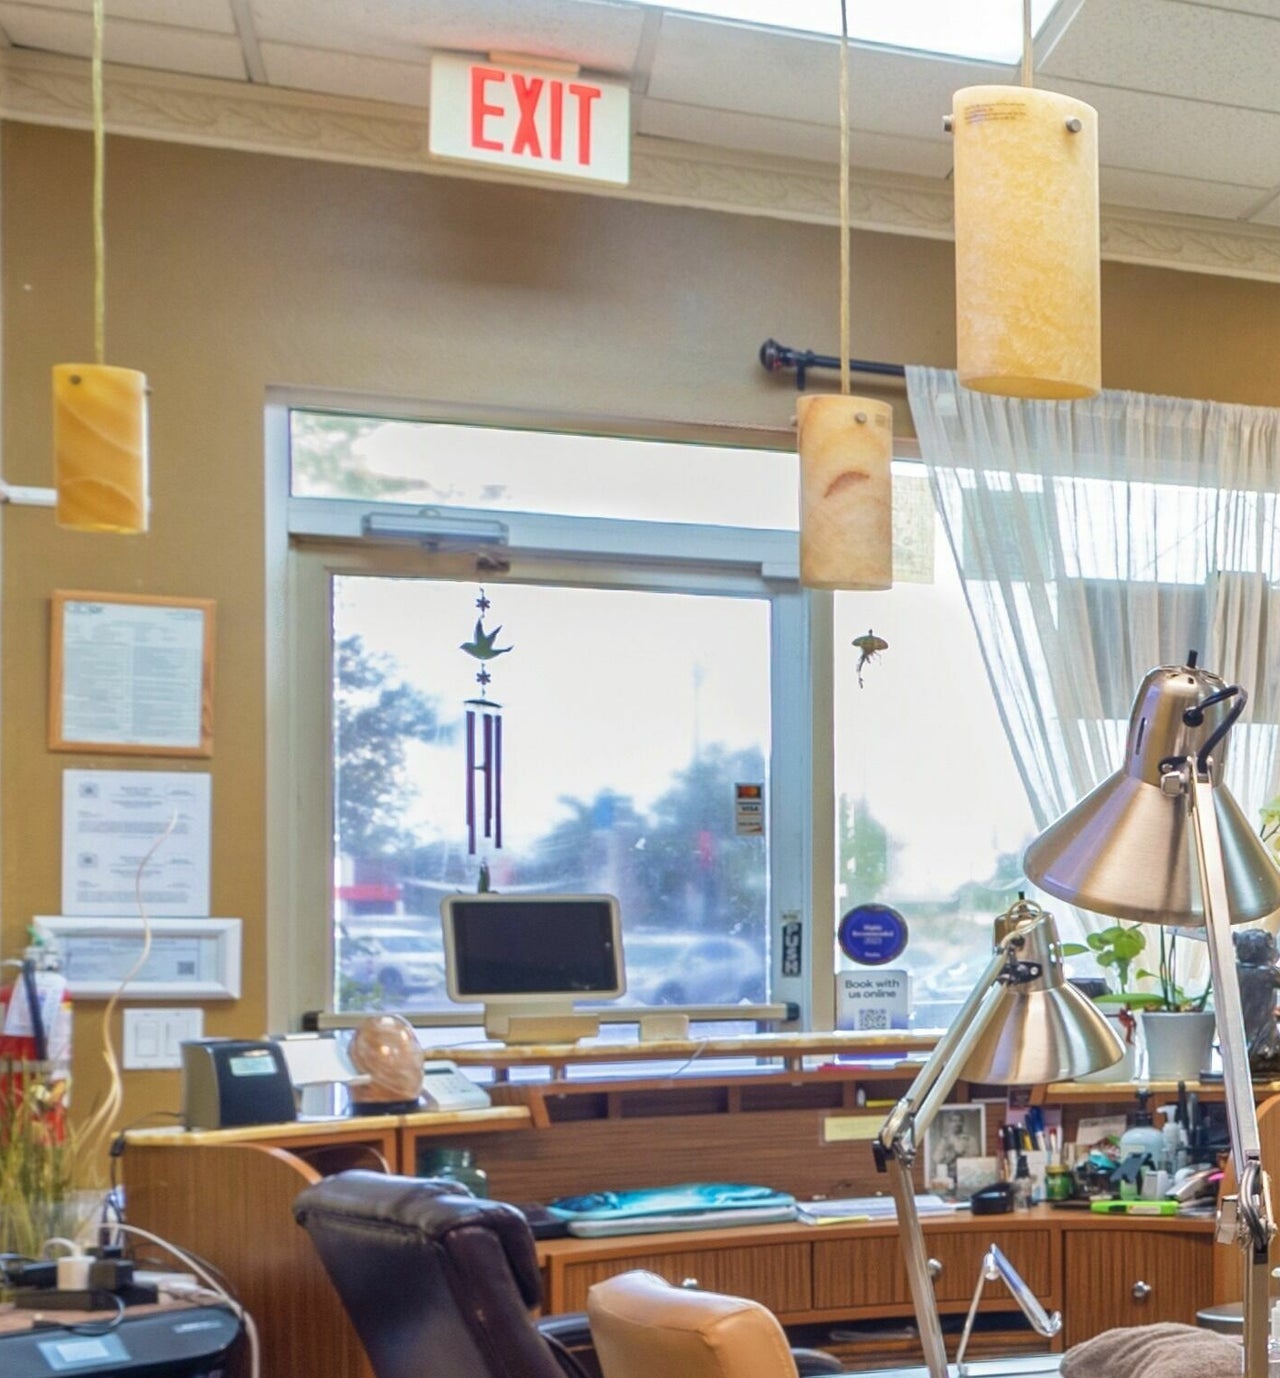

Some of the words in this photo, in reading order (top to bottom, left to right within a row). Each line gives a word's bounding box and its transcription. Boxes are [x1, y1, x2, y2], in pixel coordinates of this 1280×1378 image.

[470, 65, 602, 167] EXIT
[845, 979, 872, 989] Book
[875, 979, 900, 989] with
[848, 991, 861, 999] us
[863, 989, 897, 999] online
